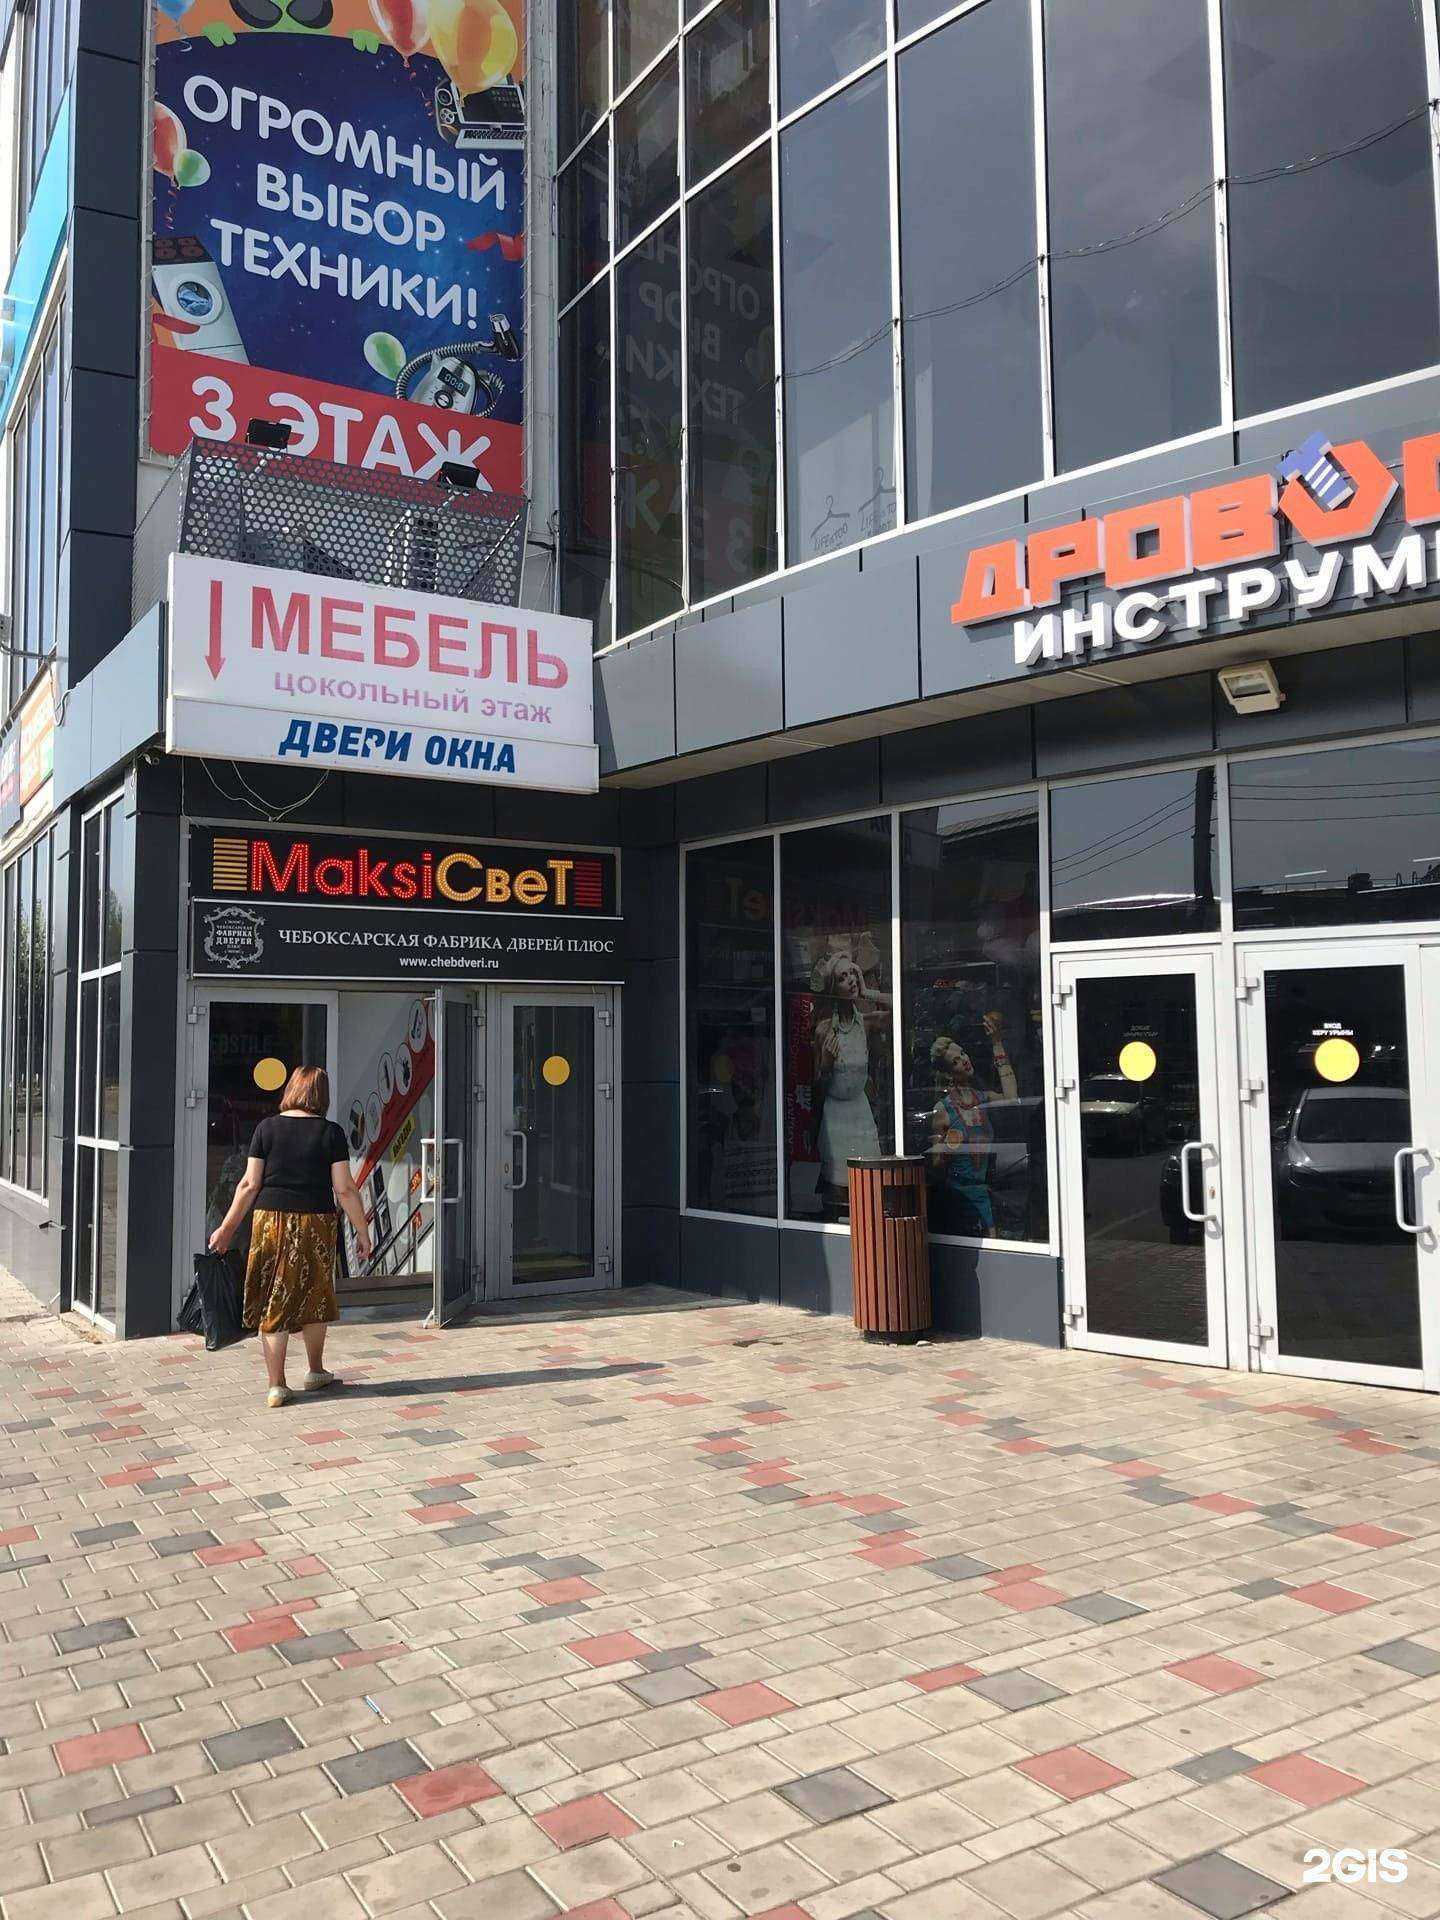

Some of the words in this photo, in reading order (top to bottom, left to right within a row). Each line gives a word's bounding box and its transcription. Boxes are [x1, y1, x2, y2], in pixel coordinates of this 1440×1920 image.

[183, 75, 505, 211] ОГРОМНЫЙ
[256, 163, 446, 251] ВЫБОР
[210, 218, 477, 330] ТЕХНИКИ!
[189, 375, 237, 442] 3
[268, 392, 494, 493] ЭТАЖ
[251, 585, 569, 689] МЕБЕЛЬ
[278, 718, 412, 762] ДВЕРИ
[424, 735, 515, 773] ОКНА
[480, 698, 553, 724] этаж
[278, 929, 420, 947] ЧЕБОКСАРСКАЯ
[423, 934, 503, 949] ФАБРИКА
[506, 935, 564, 953] ДВЕРЕЙ
[567, 939, 615, 953] ПЛЮС
[399, 955, 499, 969] www.chebdveri.ru
